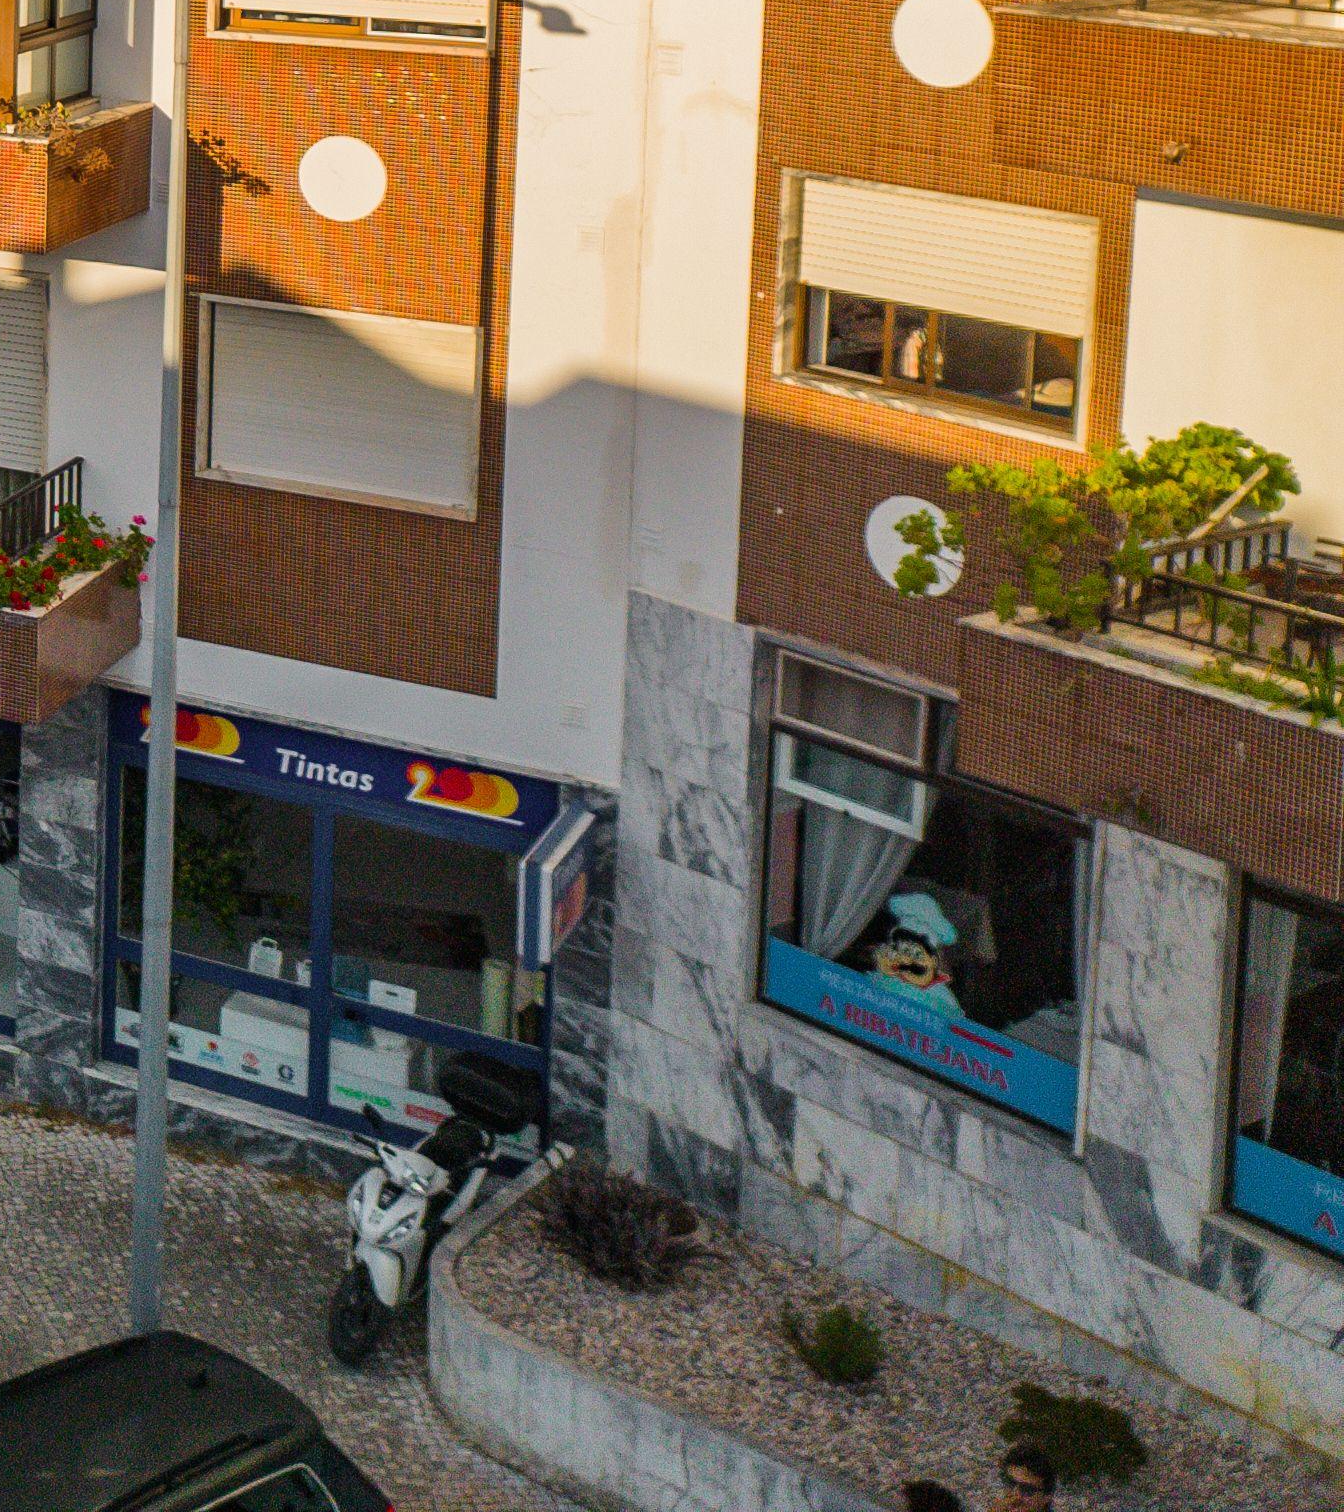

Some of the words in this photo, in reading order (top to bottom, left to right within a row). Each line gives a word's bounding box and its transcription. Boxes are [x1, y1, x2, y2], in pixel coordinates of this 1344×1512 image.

[275, 748, 374, 792] Tintas
[820, 994, 836, 1016] A
[844, 1002, 1009, 1089] RIBATEJANA
